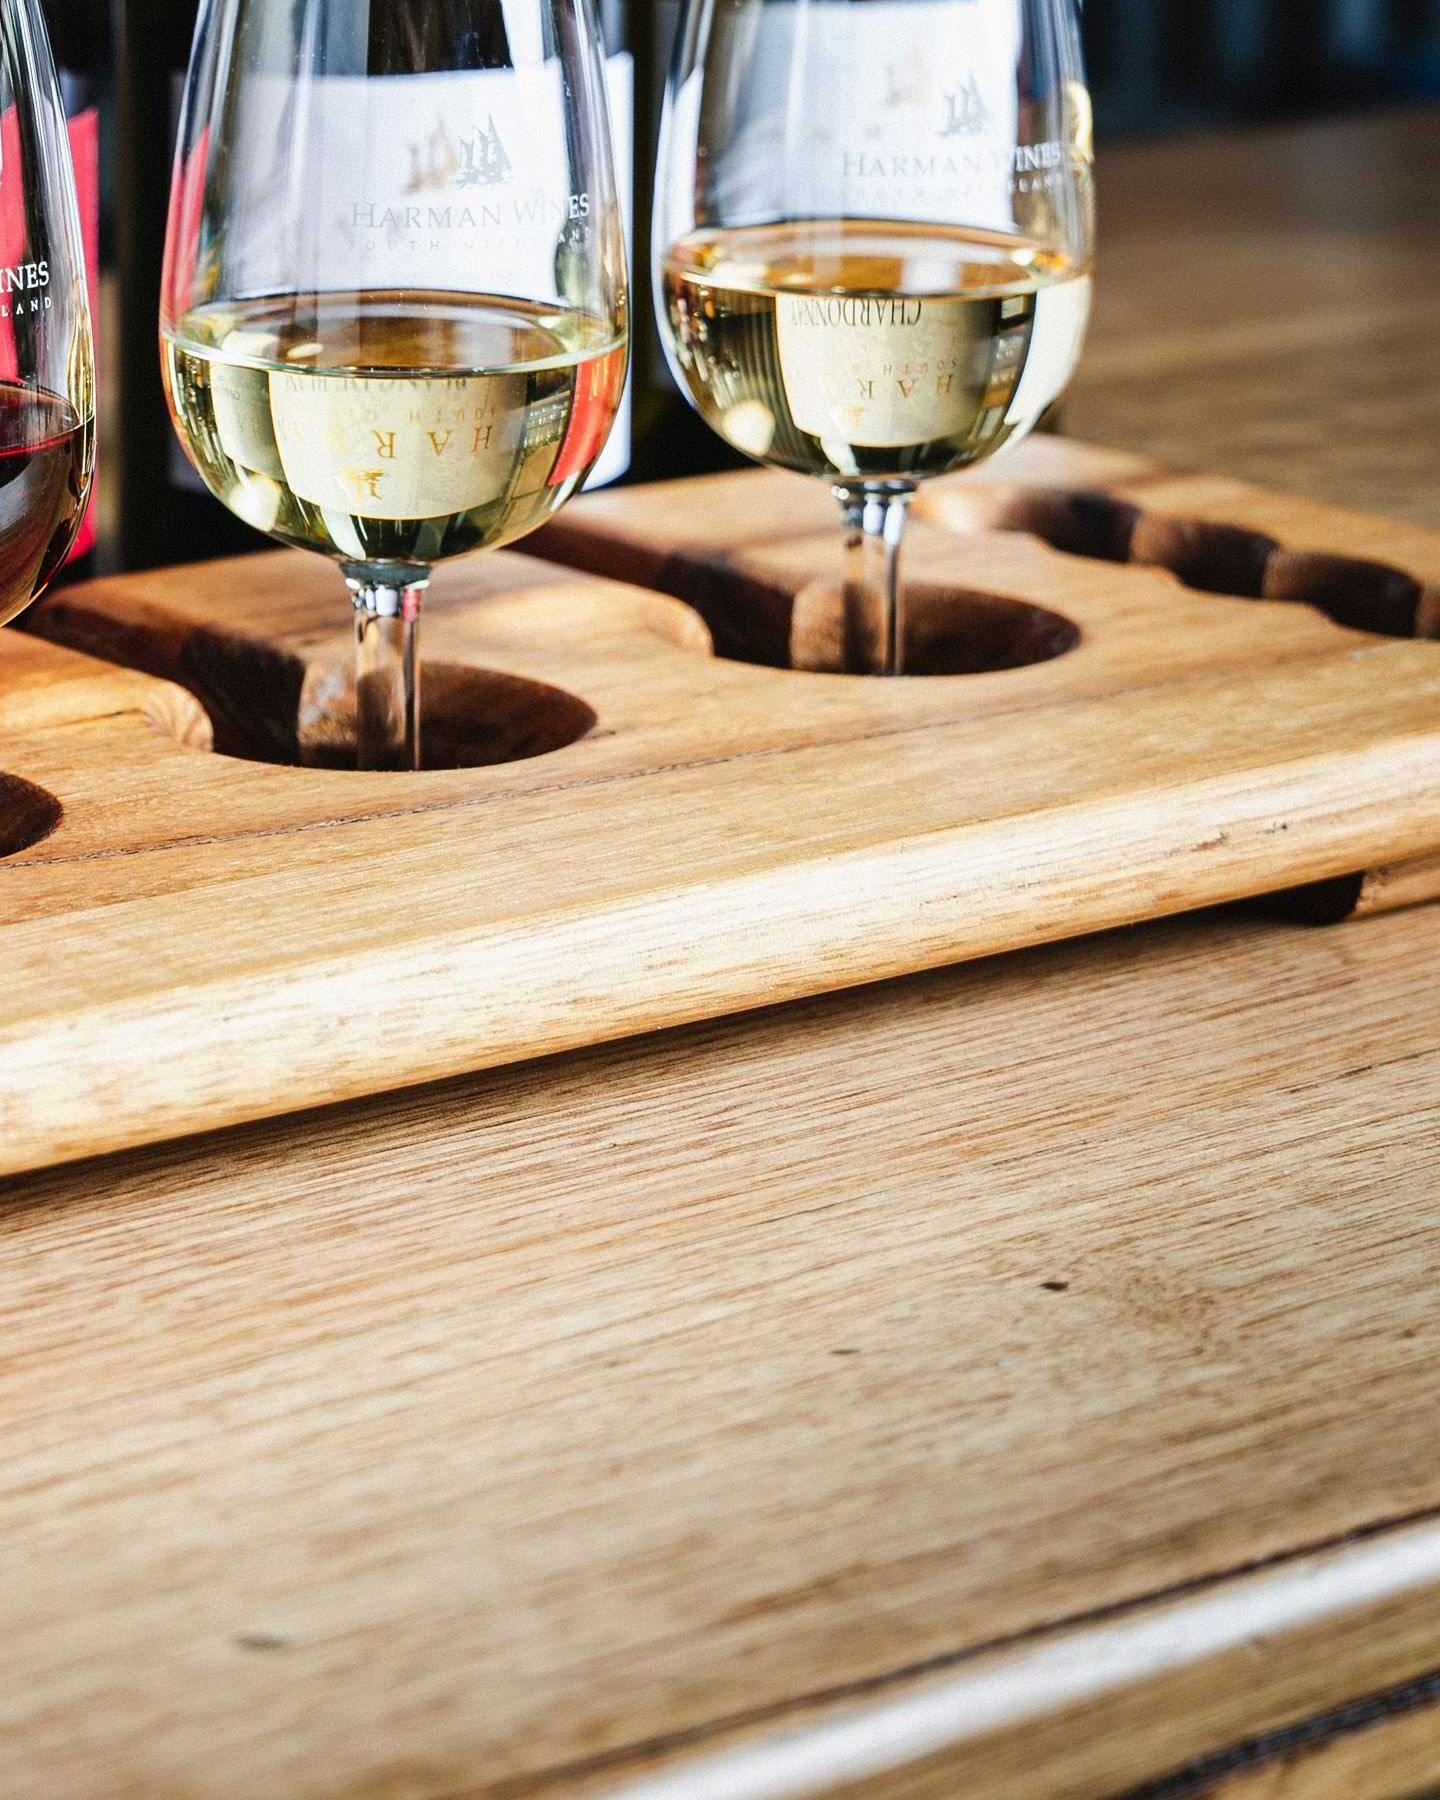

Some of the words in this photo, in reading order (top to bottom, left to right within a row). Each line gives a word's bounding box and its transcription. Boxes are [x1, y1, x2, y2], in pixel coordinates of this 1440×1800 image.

[998, 141, 1061, 173] INES
[351, 201, 501, 229] HARMAN
[513, 192, 590, 222] WINES
[348, 237, 442, 252] OUTH
